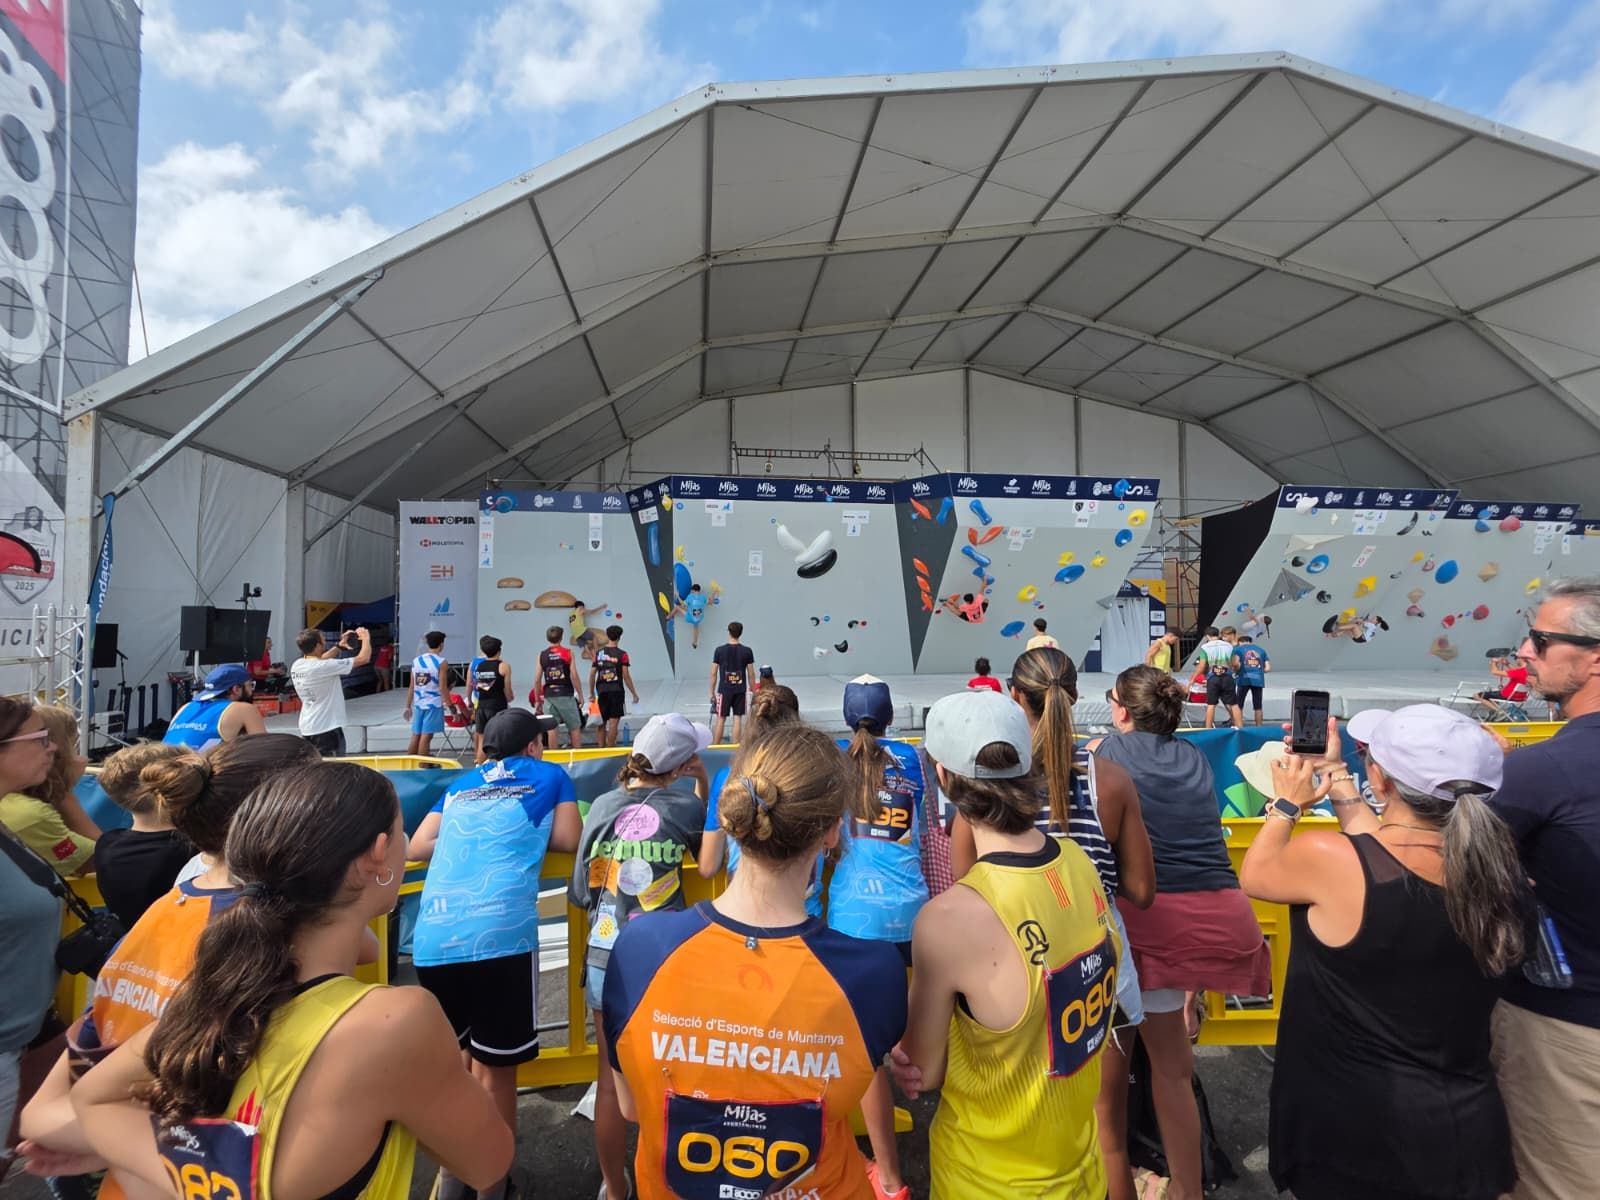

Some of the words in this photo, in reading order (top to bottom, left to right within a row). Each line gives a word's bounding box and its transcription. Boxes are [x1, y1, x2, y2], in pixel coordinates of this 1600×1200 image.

[681, 481, 701, 492] Mijas
[719, 481, 739, 493] Mijas
[757, 482, 777, 495] Mijas
[794, 483, 814, 496] Mijas
[867, 485, 886, 497] Mijas
[409, 516, 476, 525] WALLTOPIA
[15, 581, 35, 591] 2025
[1080, 954, 1103, 978] Mijas
[1061, 966, 1115, 1044] 080
[653, 1009, 702, 1028] Selecció
[706, 1017, 764, 1038] d'Esports
[768, 1028, 784, 1039] de
[787, 1030, 844, 1046] Muntanya
[651, 1031, 841, 1079] VALENCIANA
[724, 1105, 767, 1123] Mijas
[678, 1132, 810, 1179] 060
